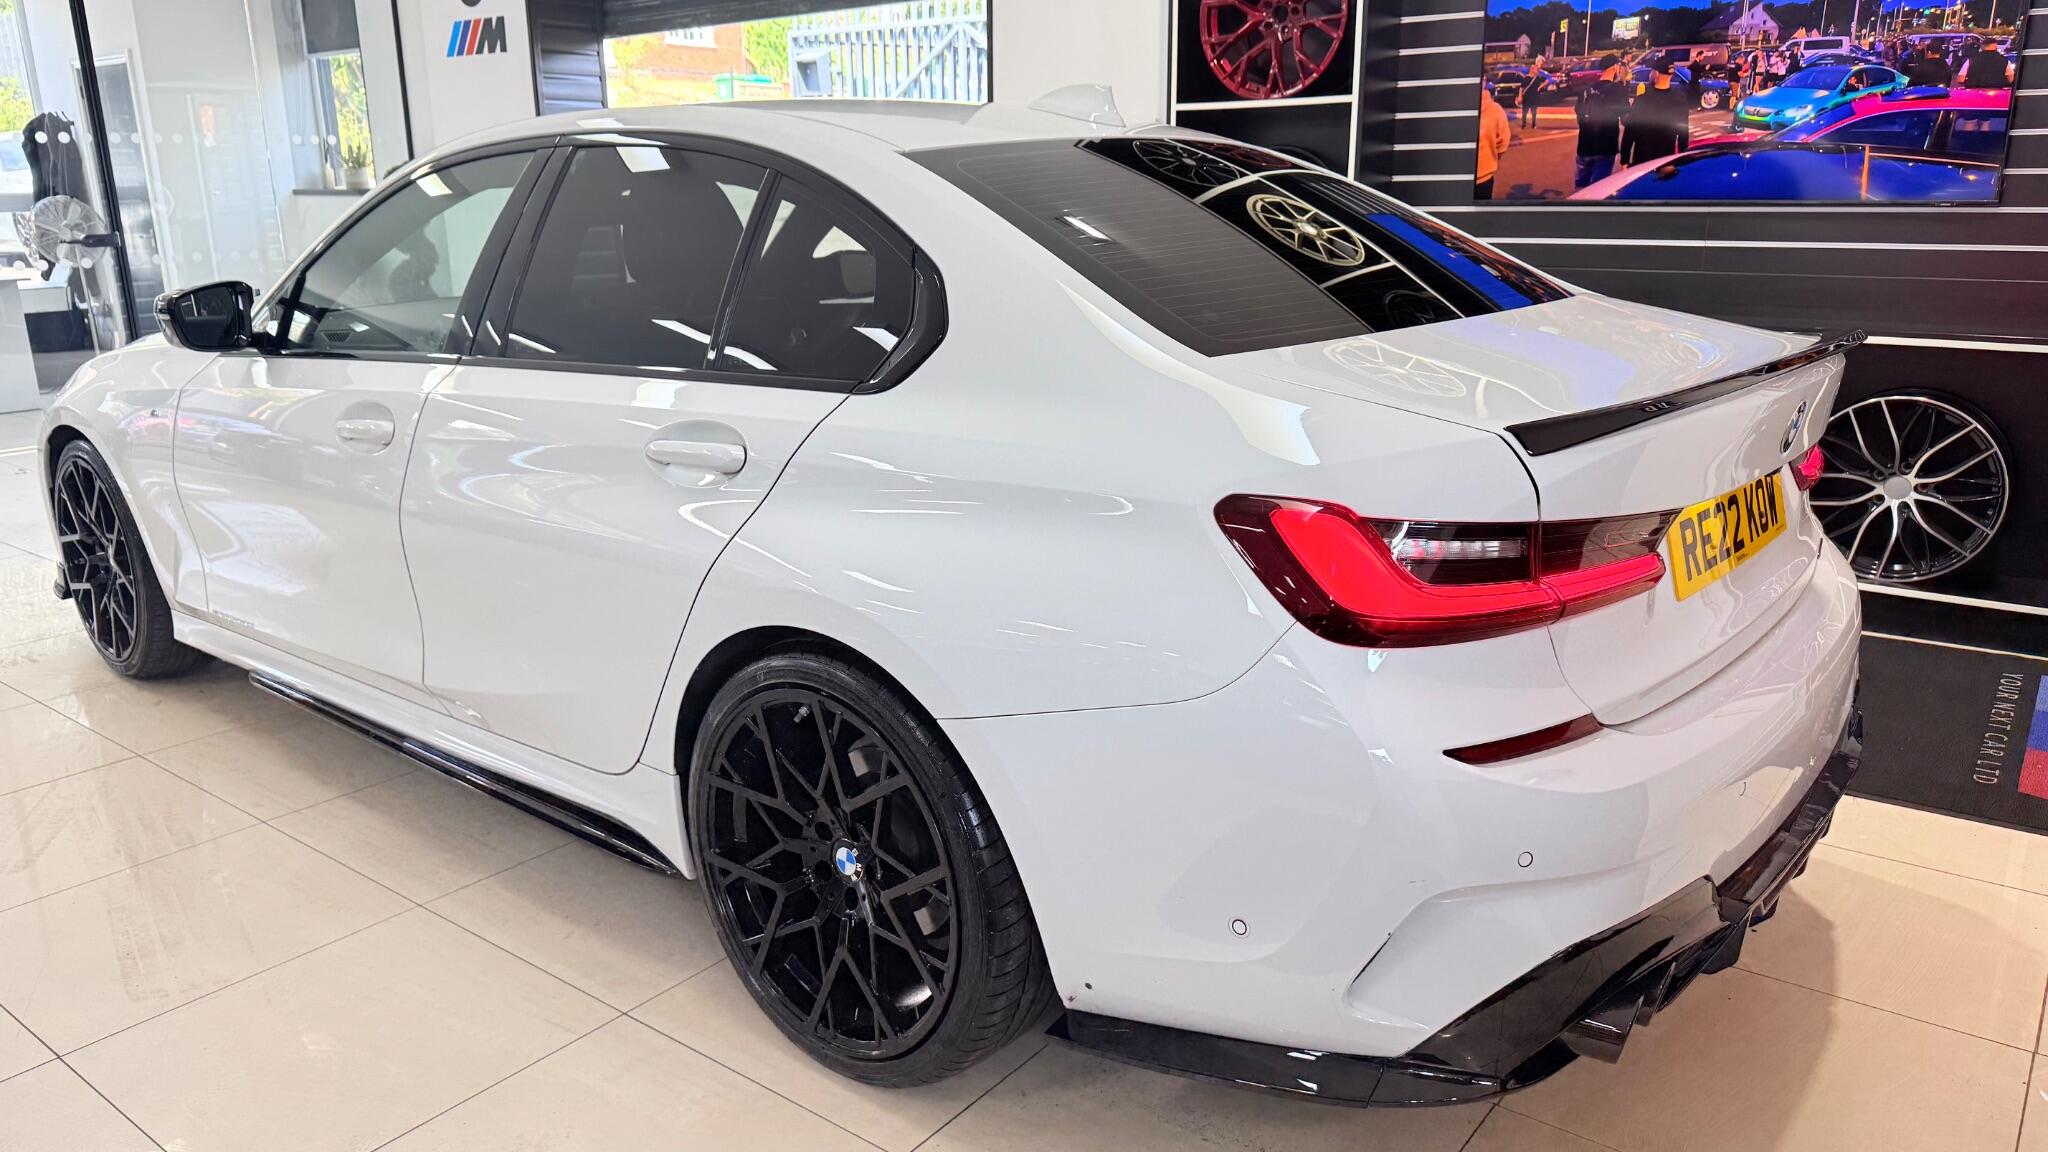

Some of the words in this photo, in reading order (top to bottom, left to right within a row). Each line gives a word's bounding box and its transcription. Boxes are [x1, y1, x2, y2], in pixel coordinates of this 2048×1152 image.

[1680, 494, 1745, 581] RE22
[1996, 673, 2023, 699] YOUR
[1988, 701, 2015, 730] NEXT
[1980, 733, 2008, 758] CAR
[1973, 760, 2001, 784] LTD
